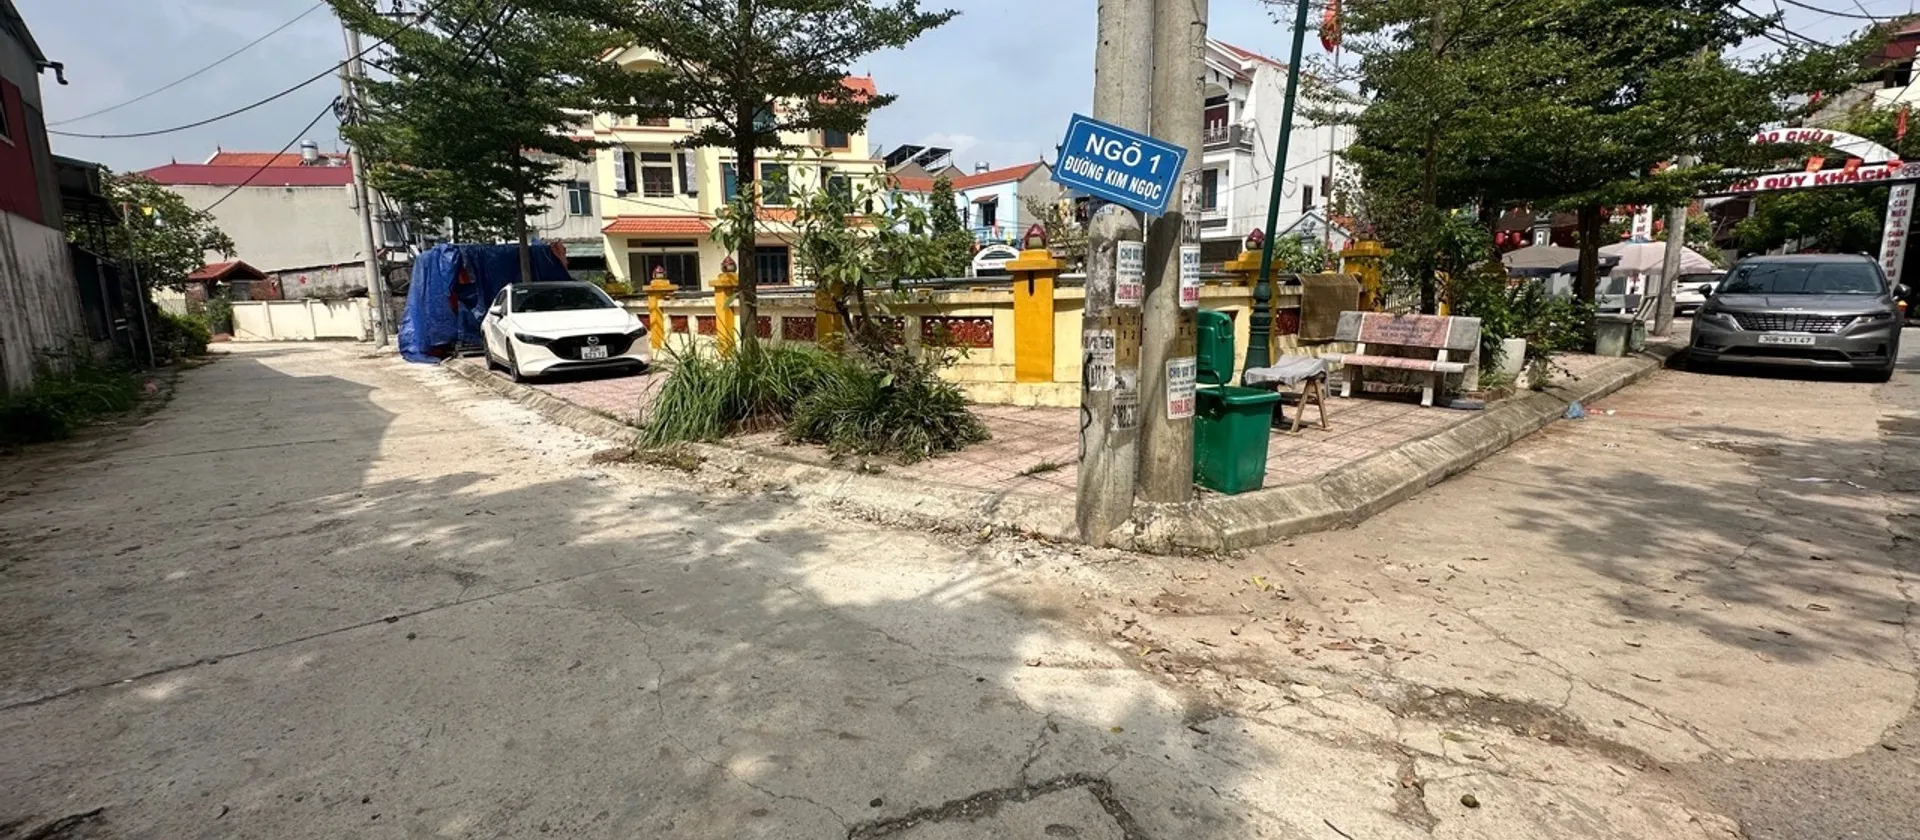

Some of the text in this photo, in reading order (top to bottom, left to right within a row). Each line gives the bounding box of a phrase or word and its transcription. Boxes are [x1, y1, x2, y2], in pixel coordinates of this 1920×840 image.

[1085, 133, 1161, 174] NGÕ 1
[1064, 155, 1104, 182] ĐƯỜNG
[1104, 168, 1128, 189] KIM
[1128, 177, 1162, 200] NGỌC
[1764, 174, 1807, 190] QUÝ
